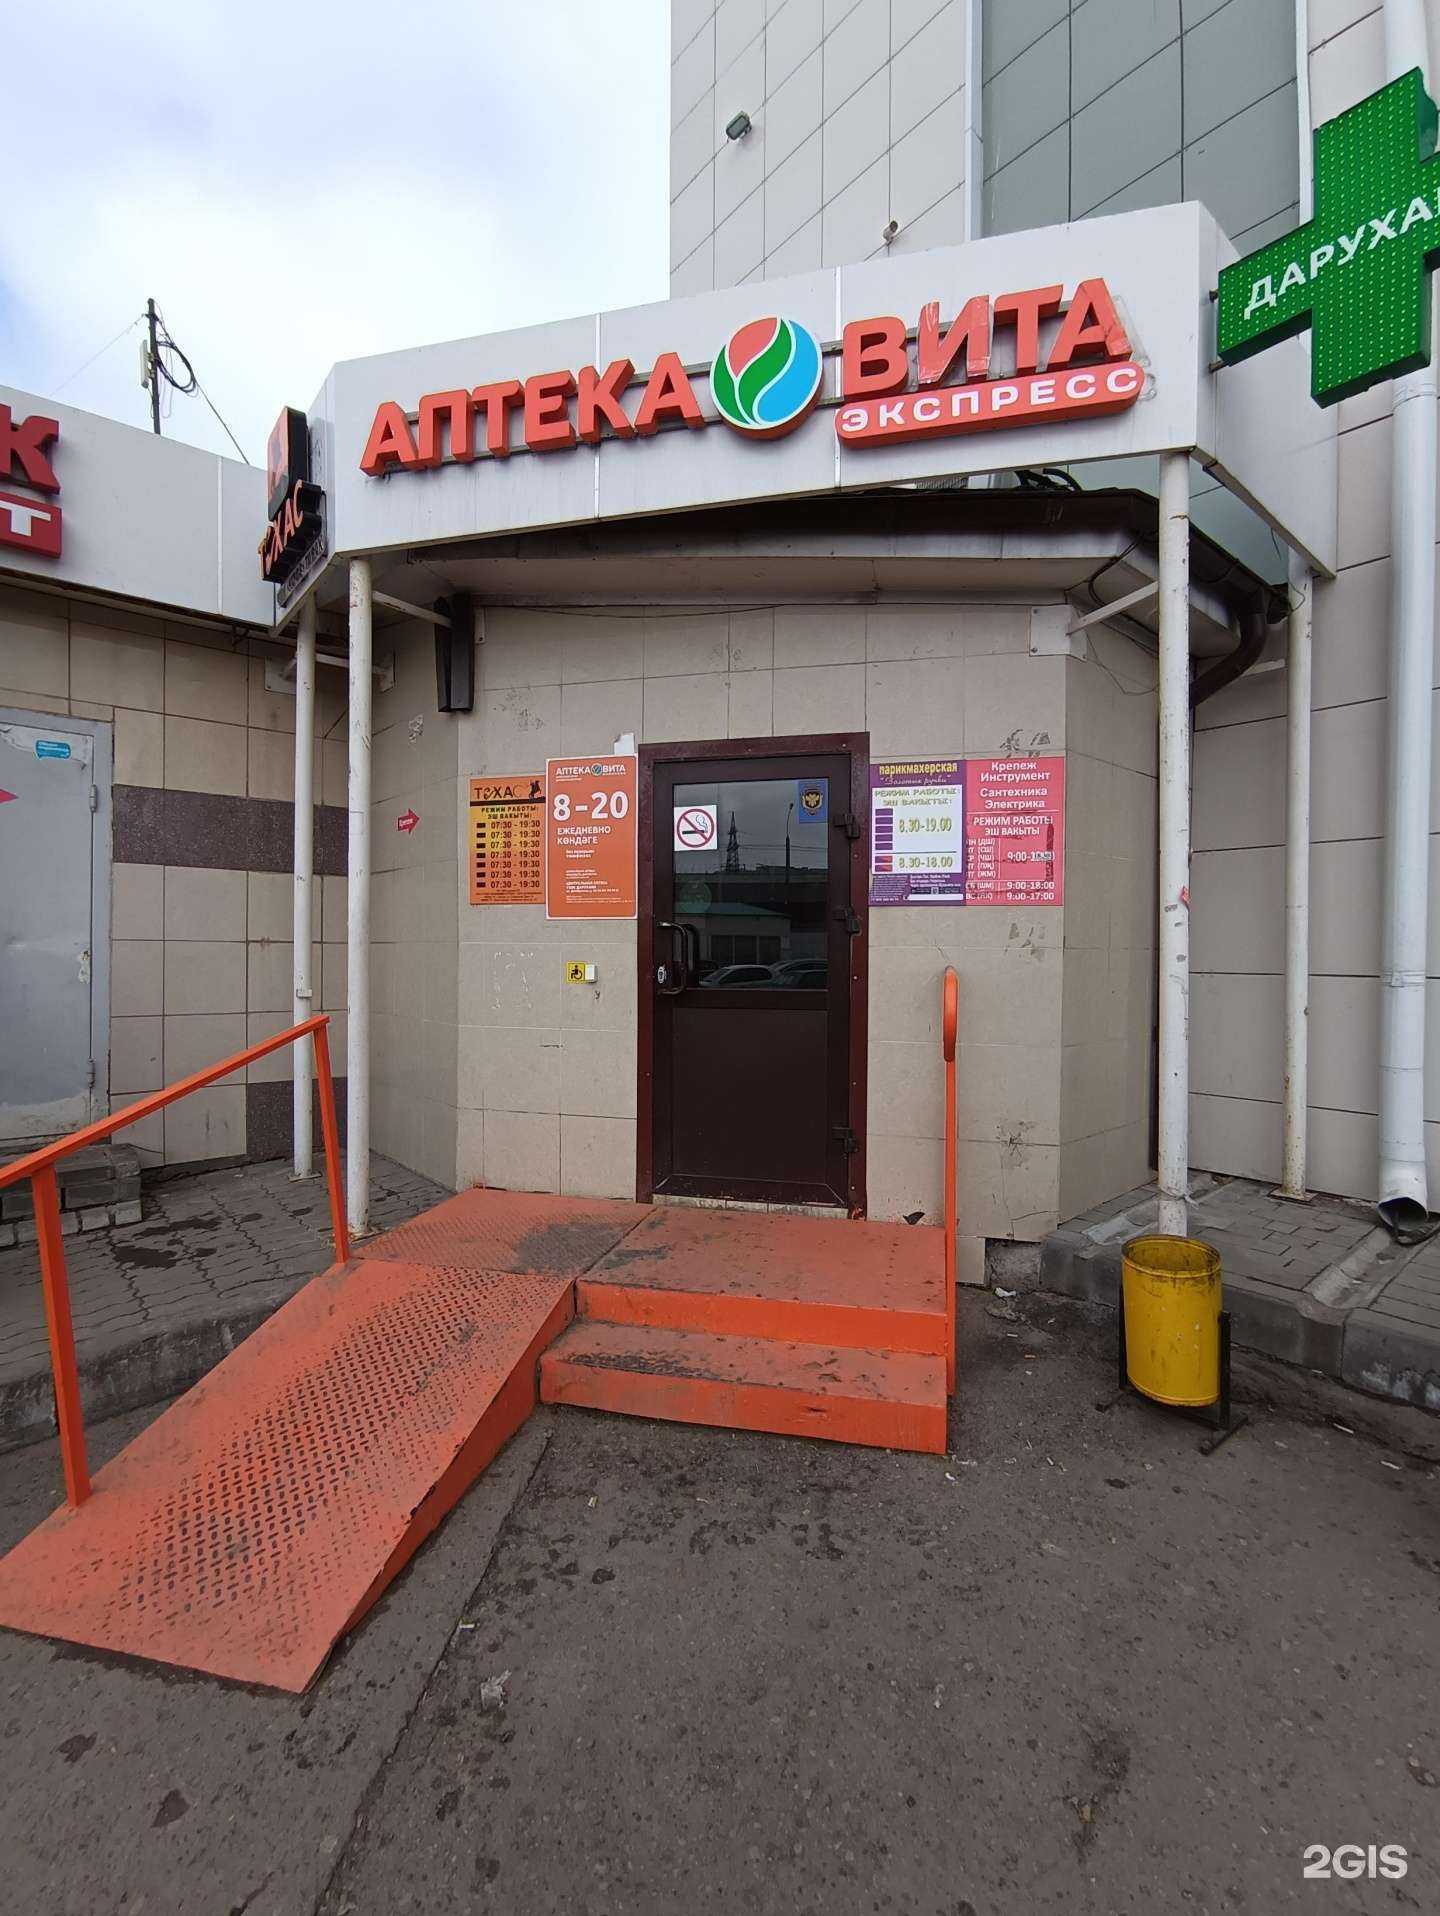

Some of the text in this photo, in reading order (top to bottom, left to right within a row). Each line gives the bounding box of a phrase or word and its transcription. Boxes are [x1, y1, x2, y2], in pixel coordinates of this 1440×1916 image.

[1243, 187, 1440, 320] ДАРУХА
[359, 278, 1133, 477] АПТЕКА ВИТА
[841, 367, 1139, 432] ЭКСПРЕСС
[556, 764, 626, 775] АПТЕКА ВИТА
[879, 763, 958, 777] парикмахерская
[991, 762, 1037, 773] Крепеж
[980, 772, 1050, 783] Инструмент
[875, 789, 910, 797] РЕЖИМ
[980, 787, 1048, 798] Сантехника
[553, 791, 629, 821] 8-20
[984, 800, 1046, 810] Электрика
[490, 821, 512, 829] 07:30
[519, 820, 541, 828] 19:30
[899, 817, 952, 833] 8.30-19.00
[973, 815, 1054, 826] РЕЖИМ РАБОТЫ
[557, 826, 611, 836] ЕЖЕДНЕВНО
[984, 827, 1040, 836] ЭШ ВАКЫТЫ
[557, 836, 598, 846] КӨНДӘГЕ
[899, 856, 953, 868] 8.30-18.00
[1006, 881, 1055, 890] 9:00-18:00
[1006, 892, 1055, 900] 9:00-17:00
